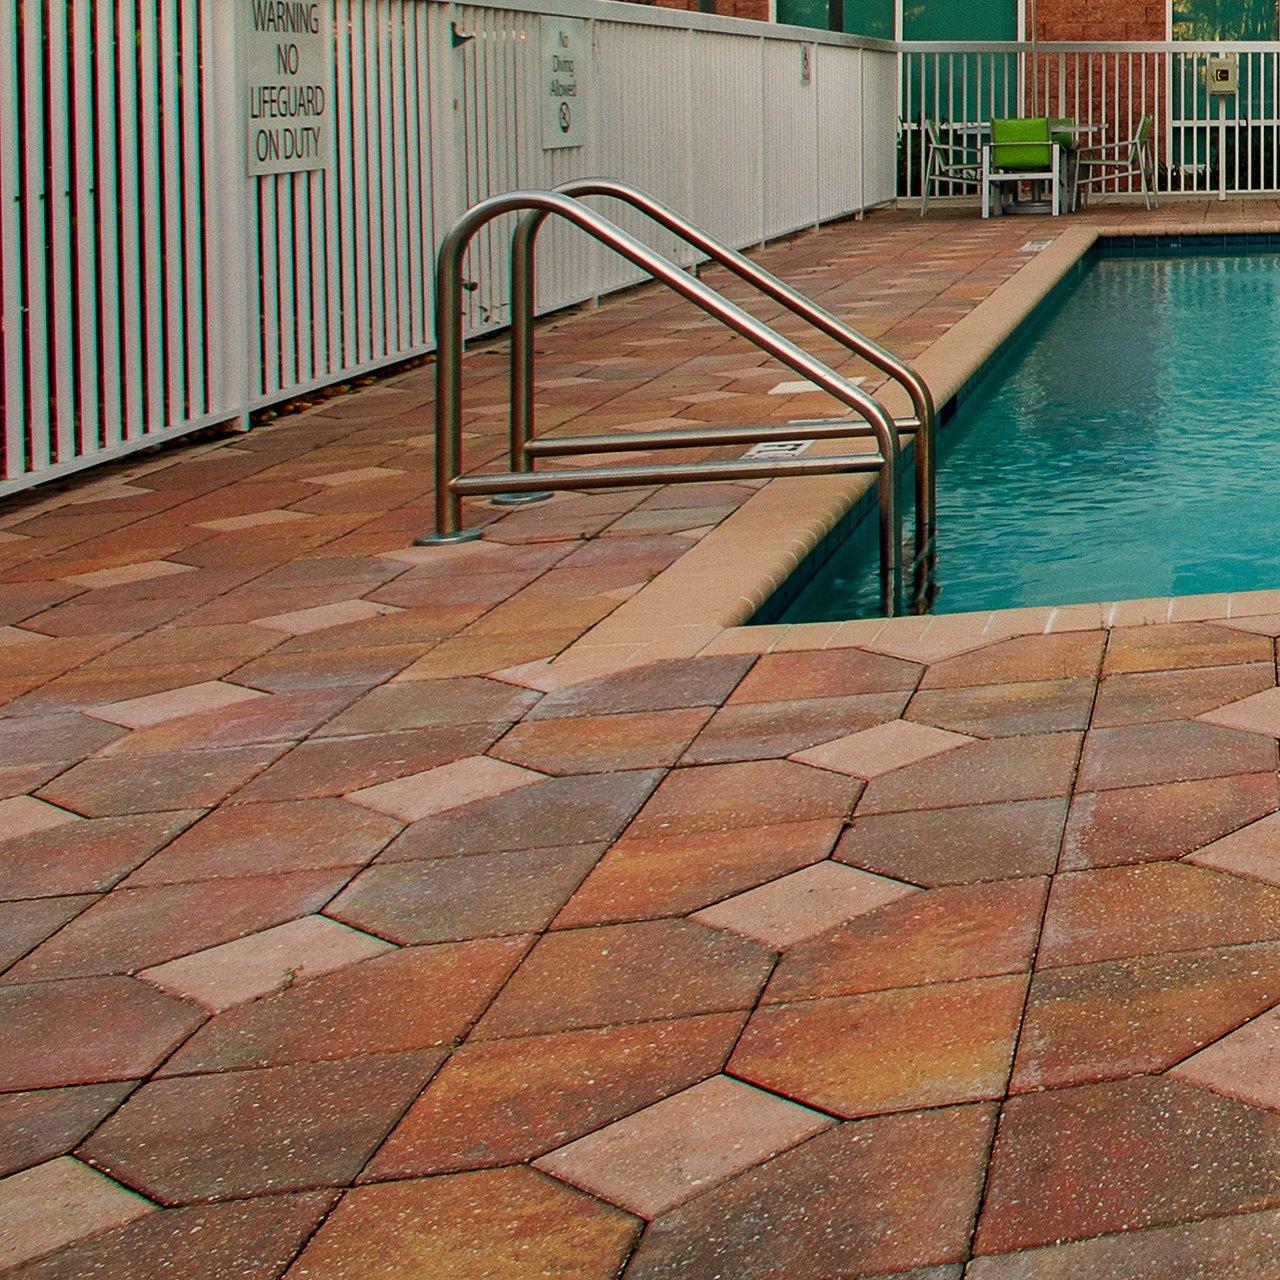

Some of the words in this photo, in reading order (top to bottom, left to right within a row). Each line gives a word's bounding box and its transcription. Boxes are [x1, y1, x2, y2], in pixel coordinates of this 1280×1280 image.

[277, 43, 300, 75] NO
[251, 85, 325, 119] LIFEGUARD
[256, 128, 280, 162] ON
[284, 126, 321, 160] DUTY
